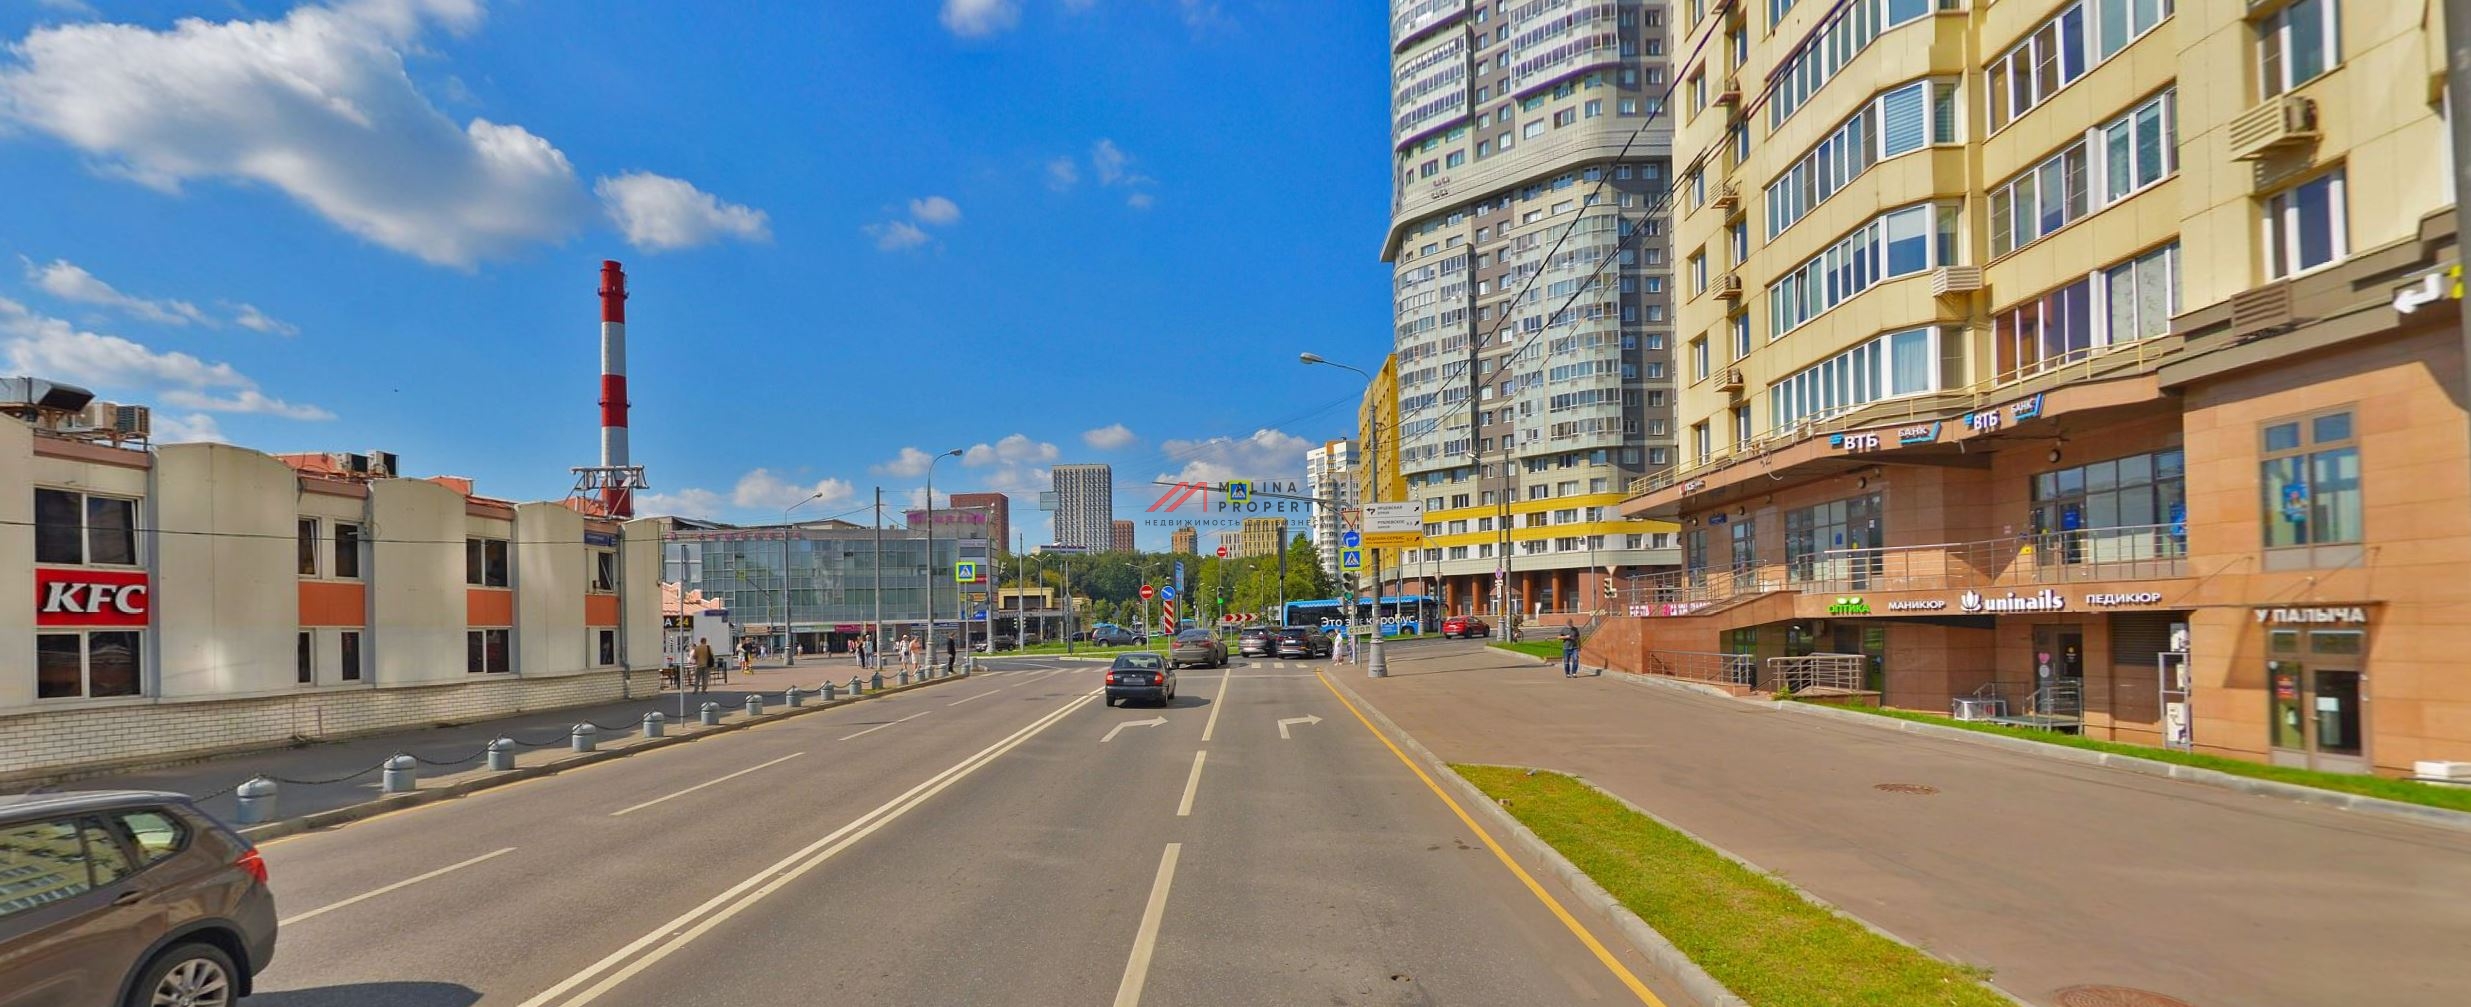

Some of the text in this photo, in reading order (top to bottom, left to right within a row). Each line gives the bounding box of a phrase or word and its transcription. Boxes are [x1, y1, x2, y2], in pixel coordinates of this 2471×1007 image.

[1974, 400, 2033, 431] ВТБ БАНК
[1844, 427, 1928, 449] ВТБ БАНК
[42, 581, 146, 614] KFC
[1985, 590, 2062, 610] uninails
[2086, 592, 2161, 605] ПЕДИКЮР
[1828, 604, 1870, 614] ОПТИКА
[1888, 600, 1945, 610] МАНИКЮР
[675, 617, 689, 626] 24
[1320, 615, 1418, 627] Это элекроус.
[2255, 608, 2365, 622] У ПАЛЫЧА
